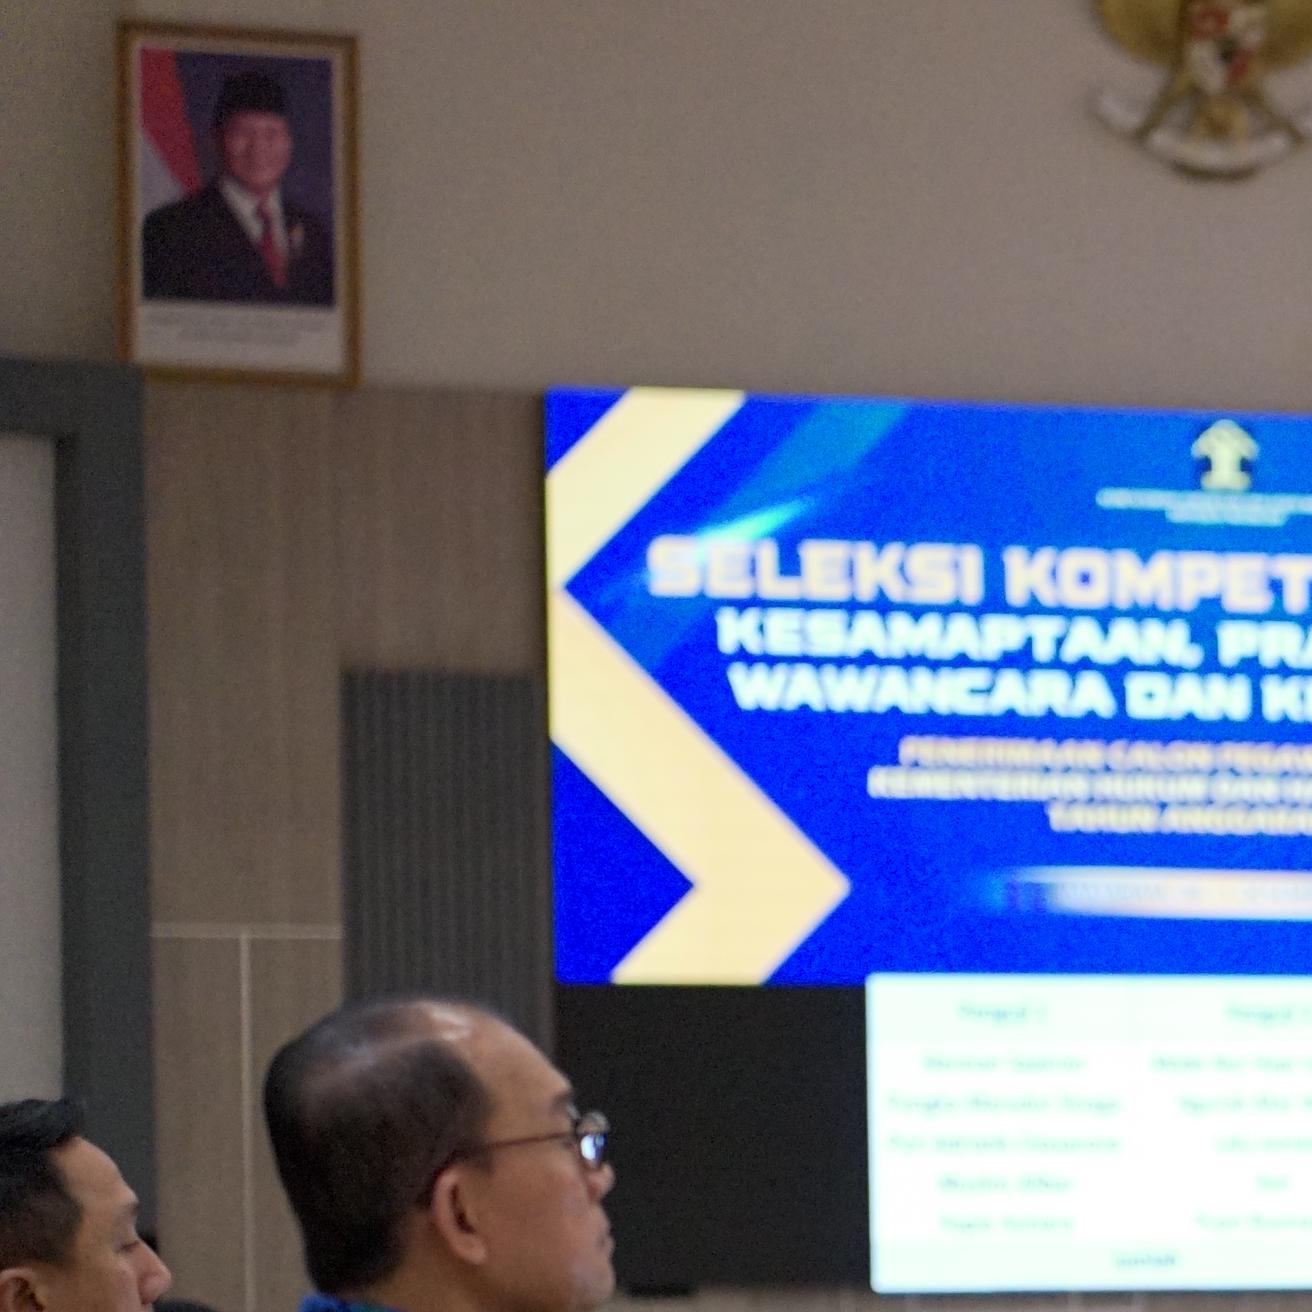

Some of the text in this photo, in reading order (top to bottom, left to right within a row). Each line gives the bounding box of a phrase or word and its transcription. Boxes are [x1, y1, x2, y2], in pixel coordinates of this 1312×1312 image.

[647, 534, 985, 606] SELEKSI
[728, 662, 1116, 717] WAWANCARA
[1124, 671, 1252, 721] DAN
